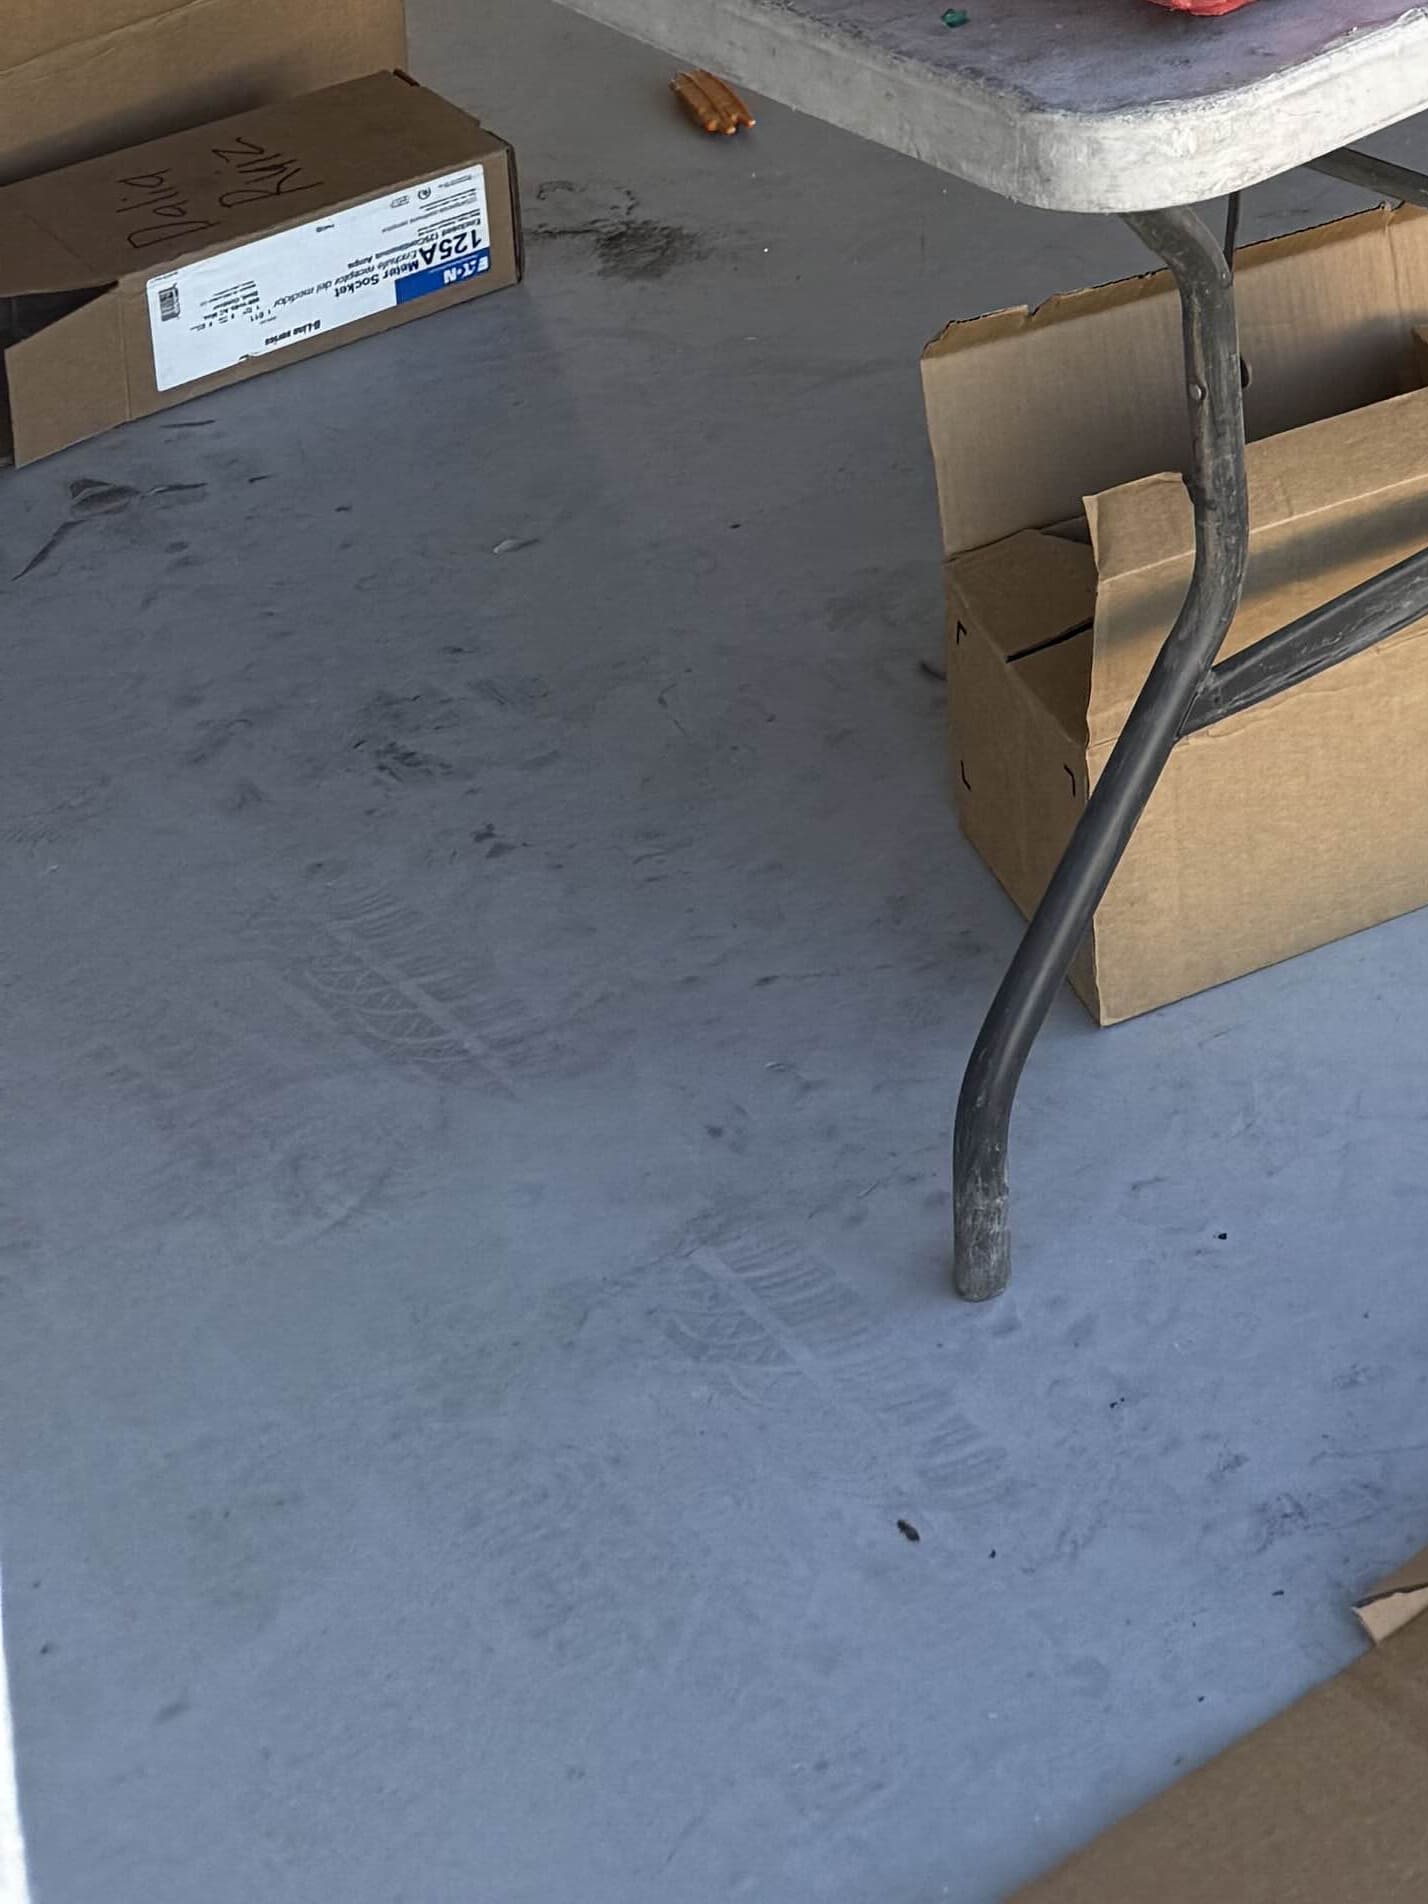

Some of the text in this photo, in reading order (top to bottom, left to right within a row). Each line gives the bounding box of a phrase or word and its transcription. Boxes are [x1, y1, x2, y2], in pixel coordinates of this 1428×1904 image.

[211, 137, 325, 208] Ruiz
[419, 229, 482, 265] 125A
[383, 259, 419, 279] Meter
[443, 255, 489, 285] EATON
[317, 280, 332, 295] del
[335, 273, 379, 297] Socket
